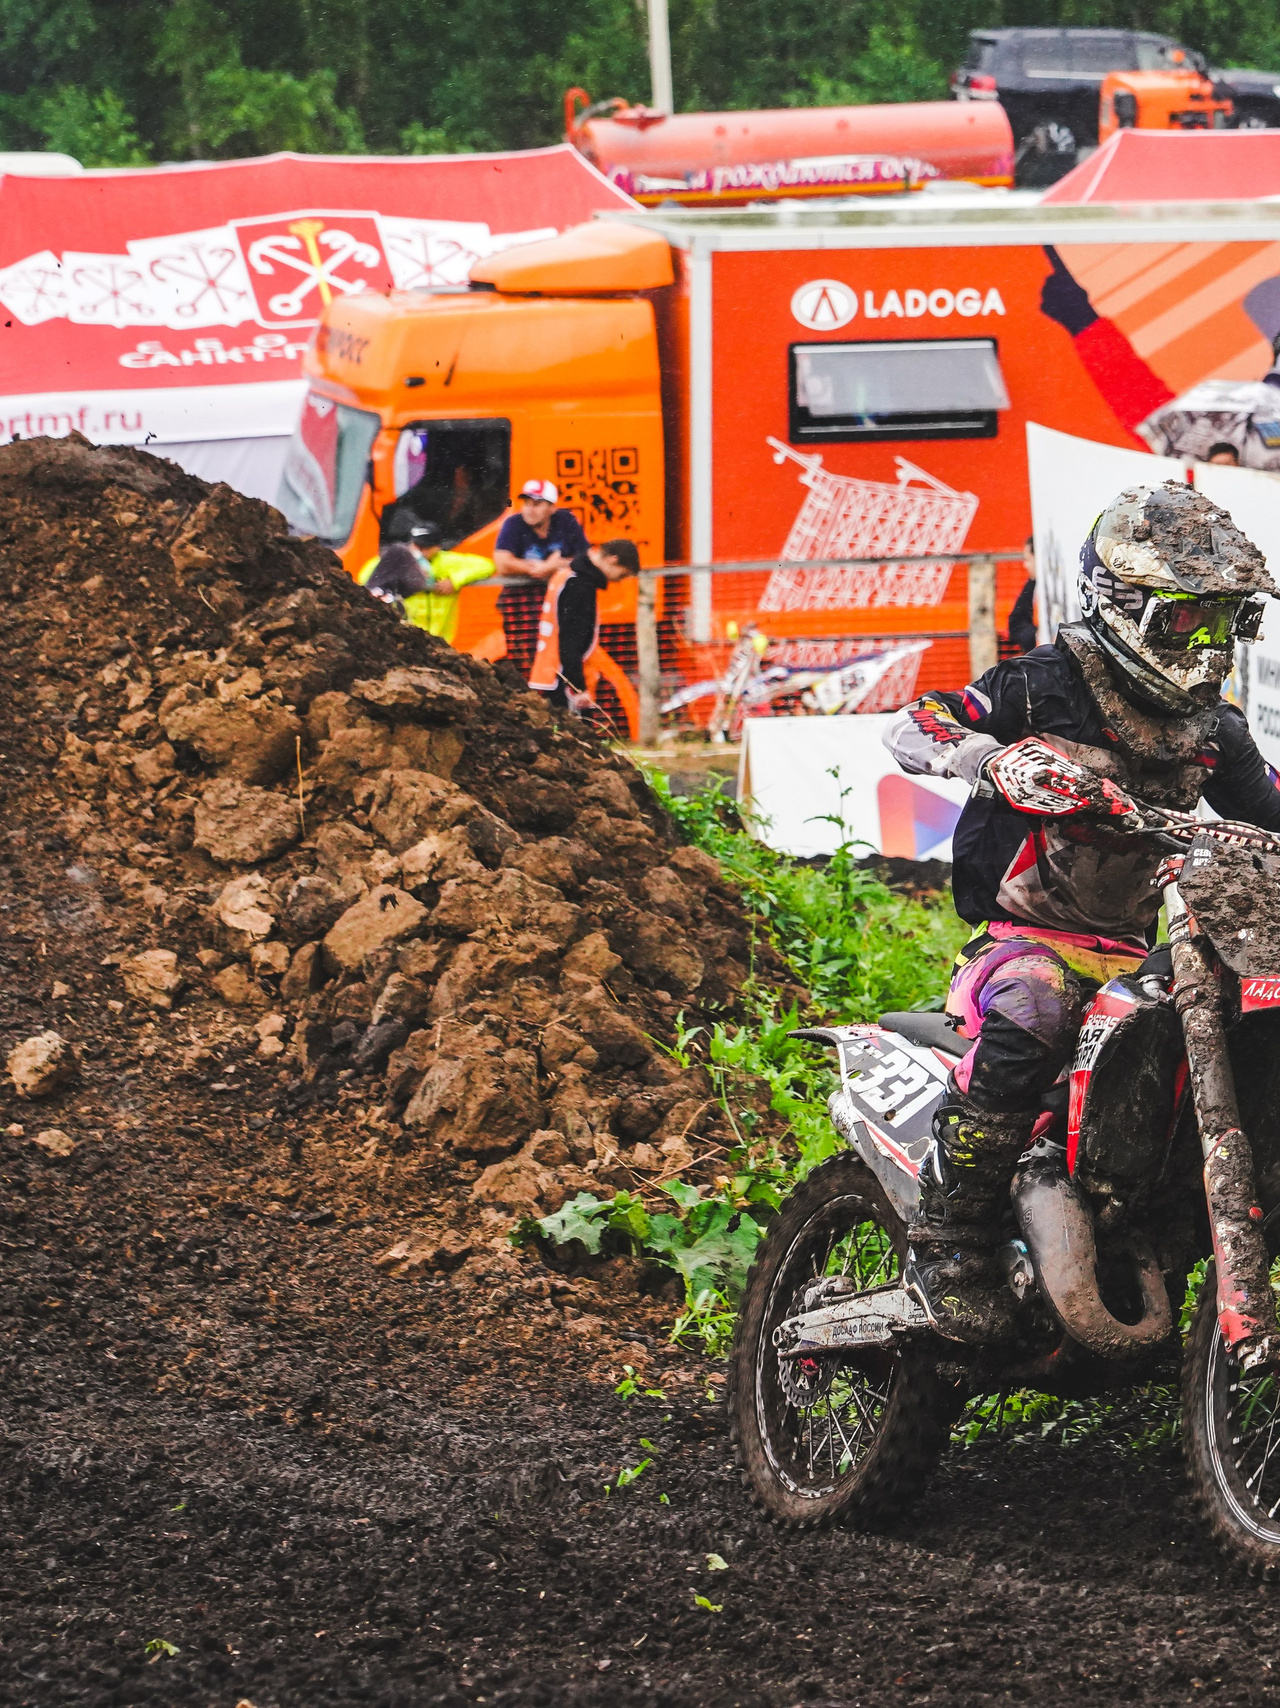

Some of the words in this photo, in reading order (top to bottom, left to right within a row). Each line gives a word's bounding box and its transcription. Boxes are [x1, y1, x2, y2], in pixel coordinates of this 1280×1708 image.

[864, 287, 1006, 318] LADOGA
[0, 405, 143, 437] rtmf.ru
[846, 1049, 946, 1129] 331
